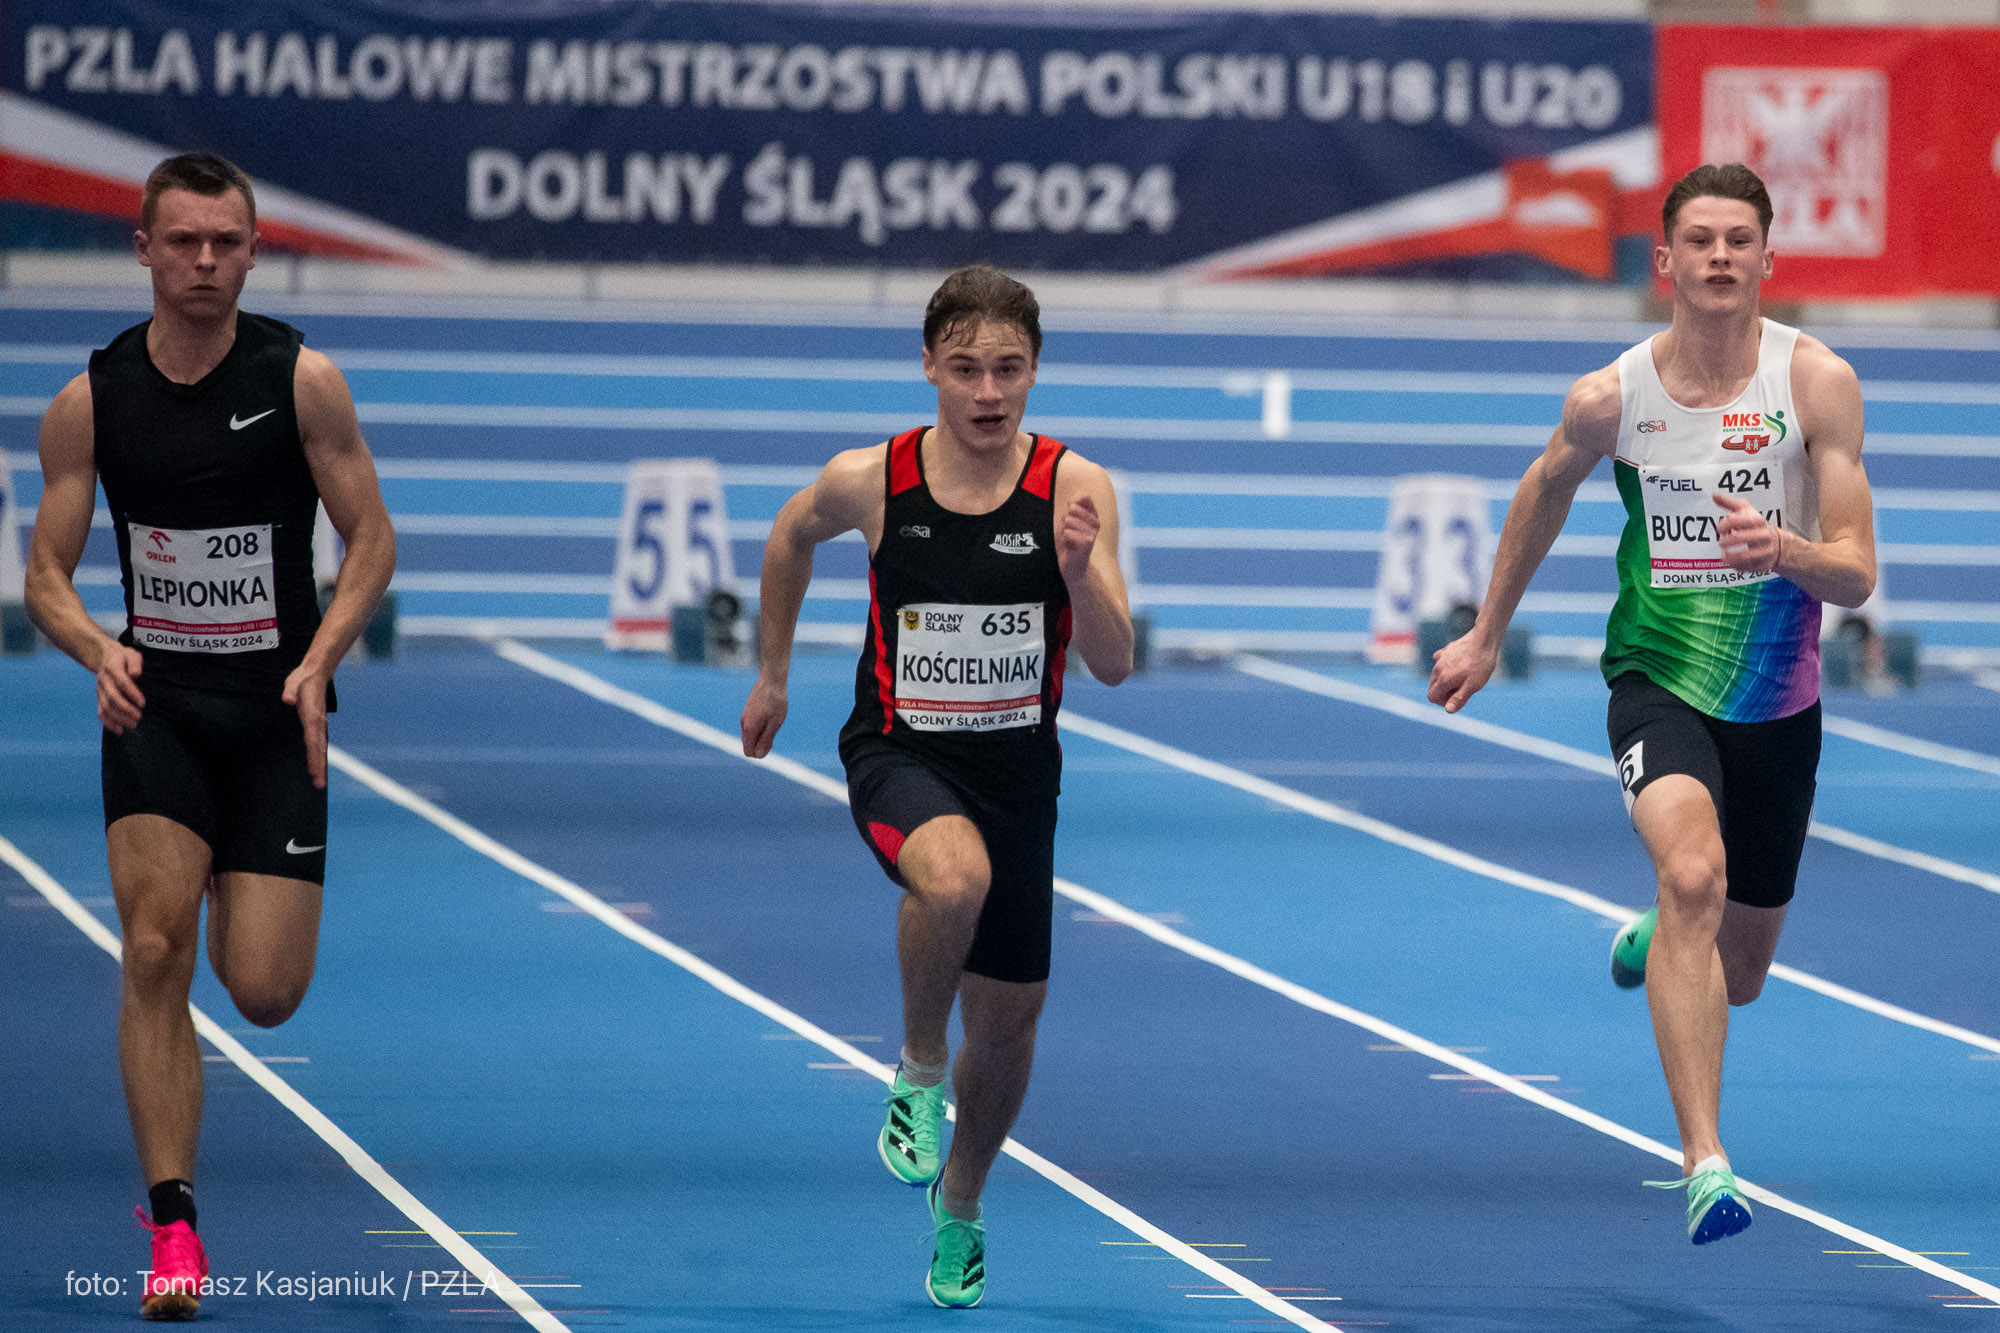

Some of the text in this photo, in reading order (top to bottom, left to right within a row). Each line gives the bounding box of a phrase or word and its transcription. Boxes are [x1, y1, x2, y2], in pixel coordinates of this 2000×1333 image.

[25, 25, 1622, 128] PZLA HALOWE MISTRZOSTWA POLSKI U18 i U20
[467, 140, 1178, 246] DOLNY ŚLĄSK 2024
[1637, 420, 1666, 433] esa
[1723, 413, 1761, 427] MKS
[1660, 479, 1702, 491] FUEL
[1718, 468, 1771, 493] 424
[900, 525, 931, 538] esa
[206, 532, 259, 559] 208
[146, 551, 176, 563] ORLEN
[1663, 574, 1702, 583] DOLNY
[1706, 571, 1745, 584] ŚLĄSK
[140, 574, 268, 607] LEPIONKA
[137, 618, 153, 627] PZLA
[154, 621, 176, 630] Halowe
[178, 624, 218, 633] Mistrzostwa
[221, 624, 241, 633] Polski
[242, 622, 255, 631] U18
[259, 619, 273, 628] U20
[925, 612, 963, 623] DOLNY
[981, 611, 1031, 636] 635
[925, 621, 961, 634] ŚLĄSK
[147, 633, 263, 650] DOLNY ŚLĄSK 2024
[902, 651, 1040, 685] KOŚCIELNIAK
[918, 702, 943, 710] Halowe
[945, 703, 988, 711] Mistrzostwa
[910, 711, 1027, 728] DOLNY ŚLĄSK 2024
[1620, 753, 1634, 792] 6
